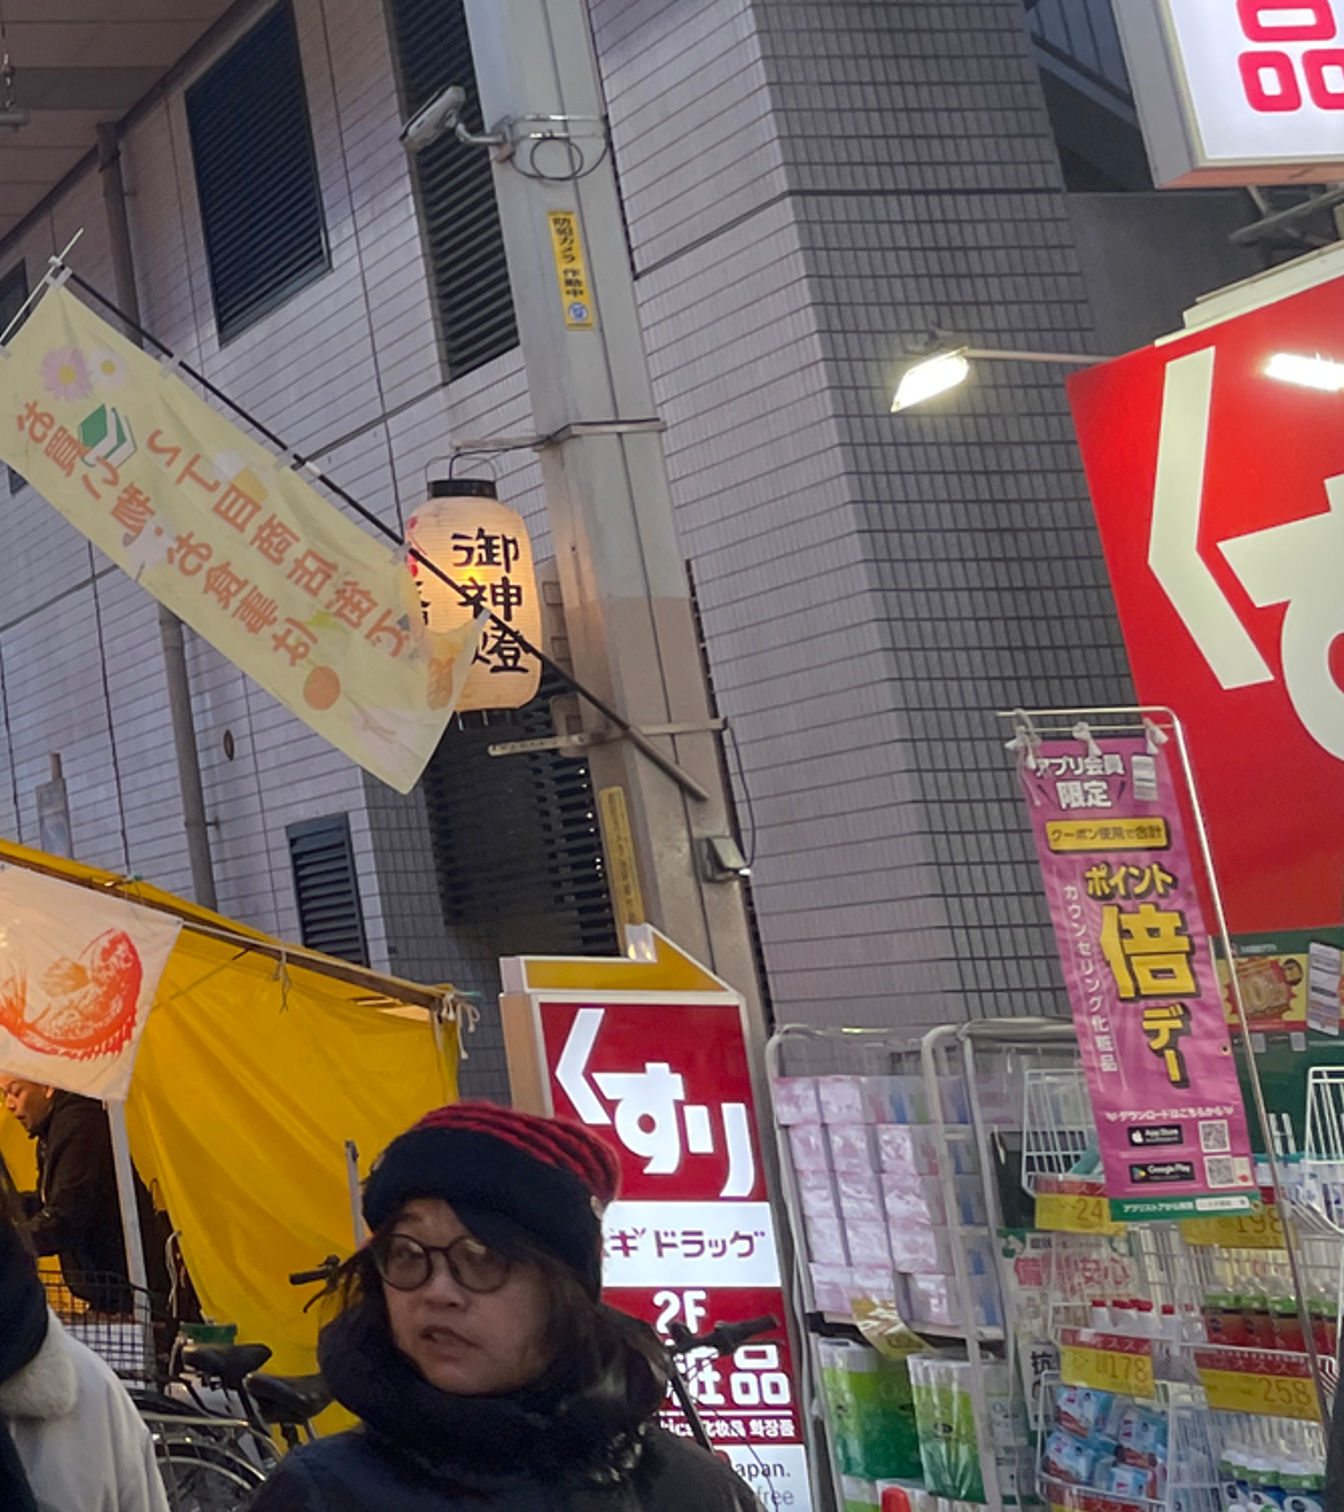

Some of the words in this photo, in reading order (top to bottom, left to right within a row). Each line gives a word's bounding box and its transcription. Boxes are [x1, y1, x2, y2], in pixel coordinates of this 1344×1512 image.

[1055, 780, 1113, 810] 限定
[1084, 860, 1175, 898] ポイント
[1099, 902, 1197, 1000] 倍
[1141, 1001, 1184, 1083] デー
[556, 1007, 756, 1198] くすり
[602, 1228, 765, 1258] ギドラッグ
[652, 1290, 707, 1335] 2F
[734, 1462, 792, 1483] apan.
